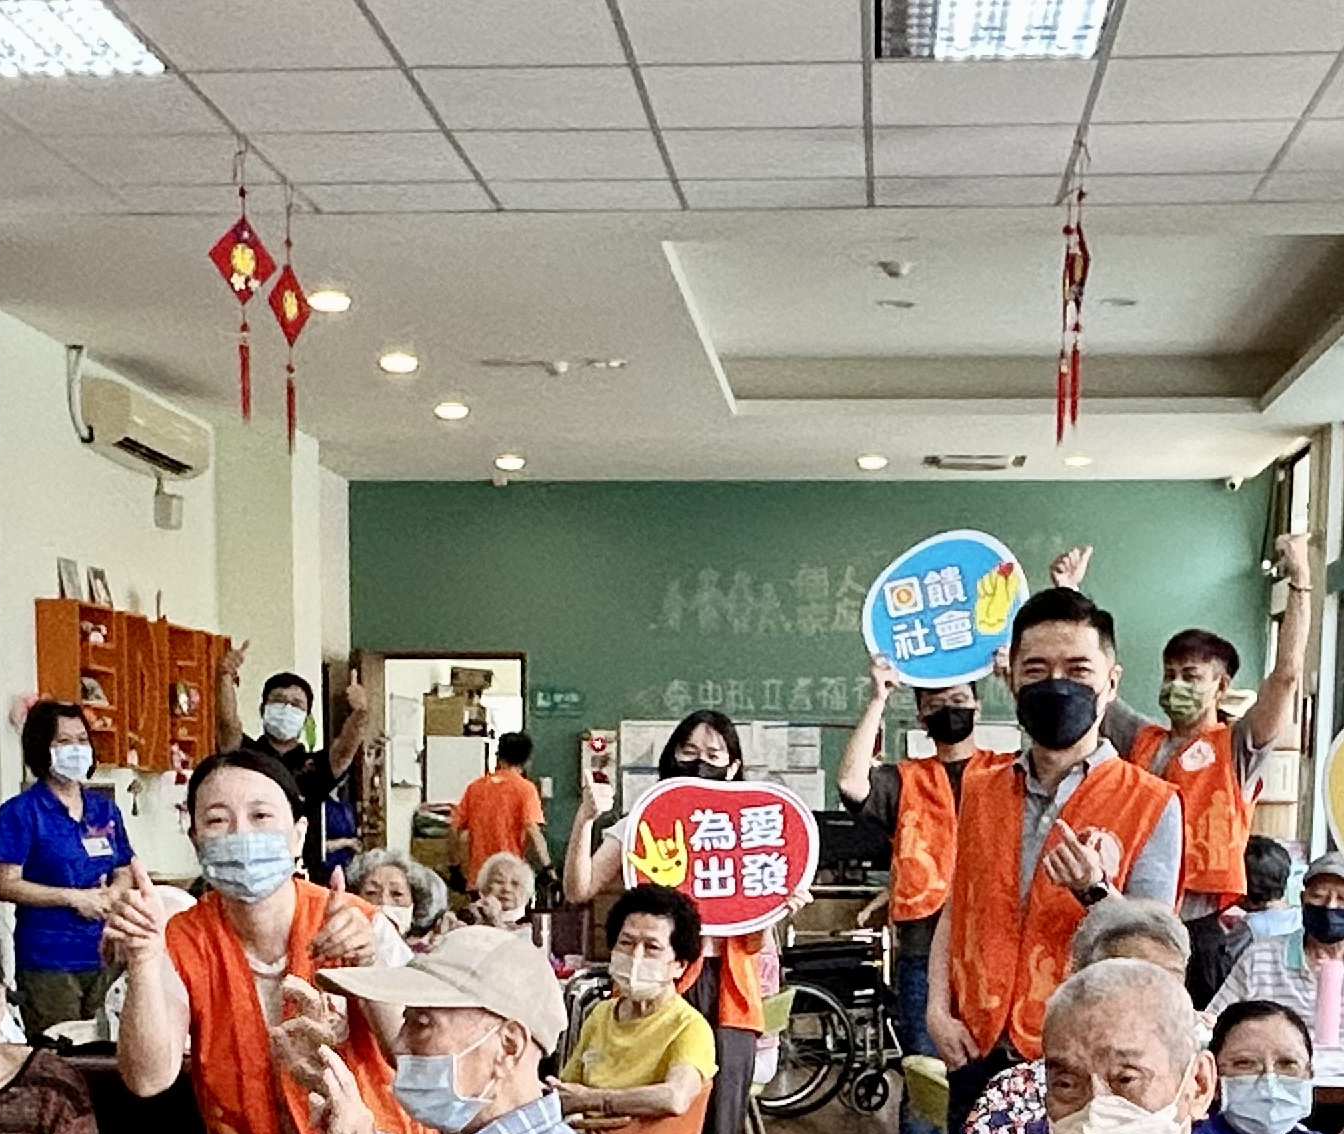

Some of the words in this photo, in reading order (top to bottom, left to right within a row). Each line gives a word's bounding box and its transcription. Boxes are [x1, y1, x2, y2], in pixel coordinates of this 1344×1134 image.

[885, 566, 968, 618] 回饋
[892, 609, 974, 661] 社會
[689, 804, 786, 851] 為愛
[693, 852, 789, 898] 出發
